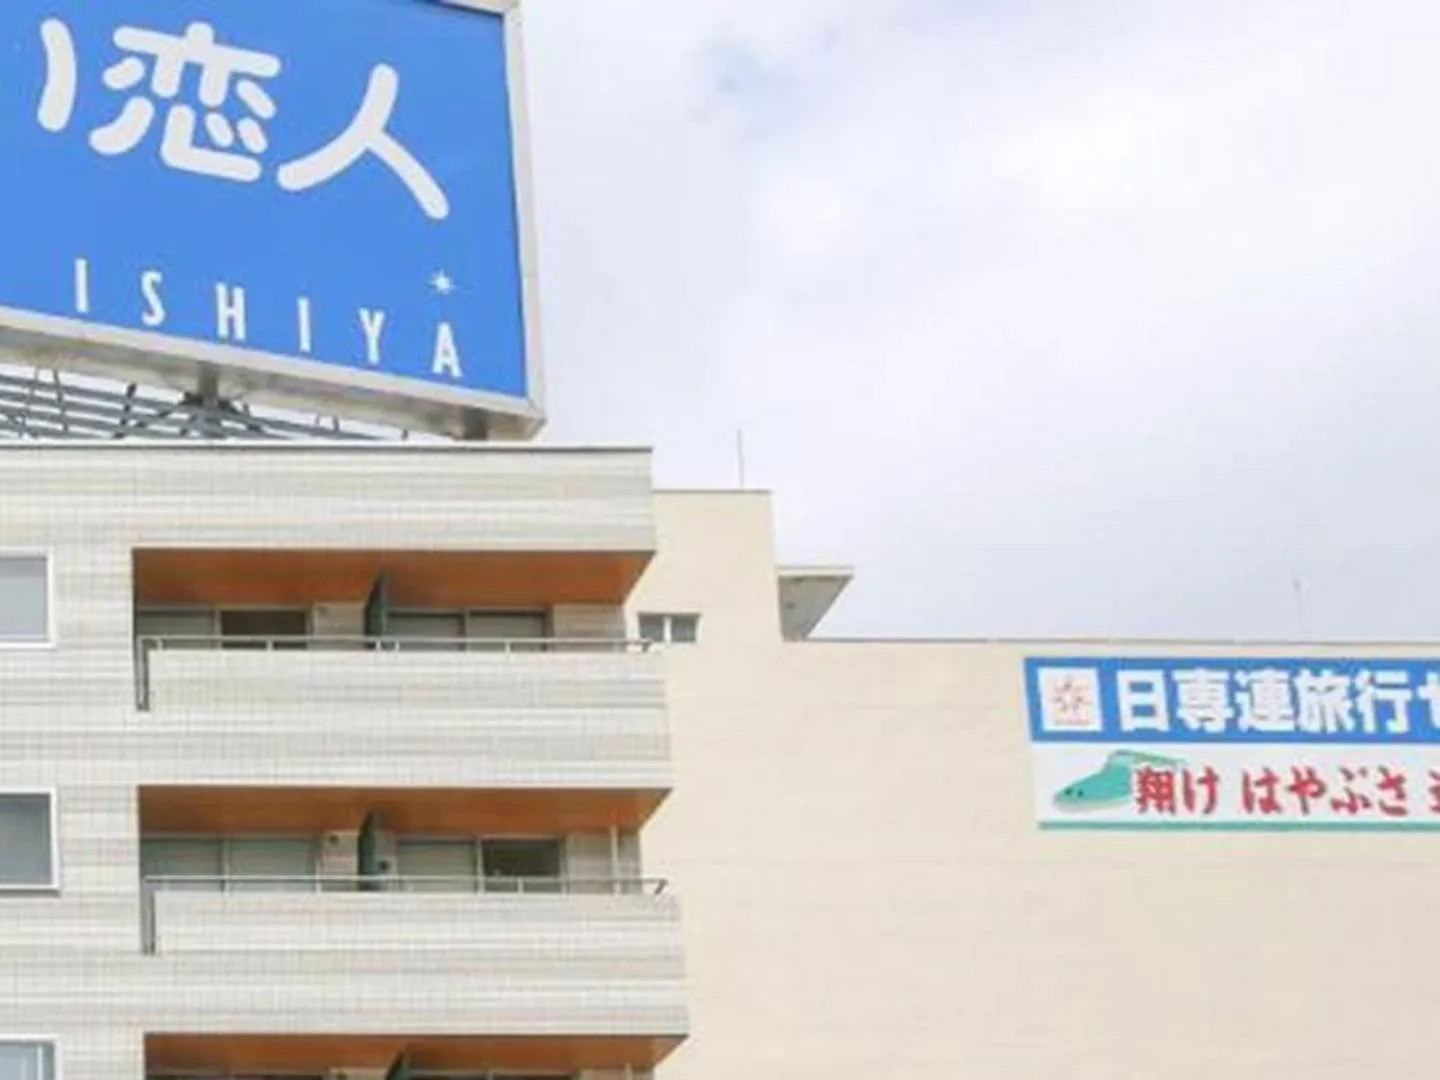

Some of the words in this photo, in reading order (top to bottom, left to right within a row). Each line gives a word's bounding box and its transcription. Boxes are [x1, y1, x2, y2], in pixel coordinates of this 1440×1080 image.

[74, 257, 462, 378] ISHIYA
[1241, 764, 1409, 817] はやぶさ
